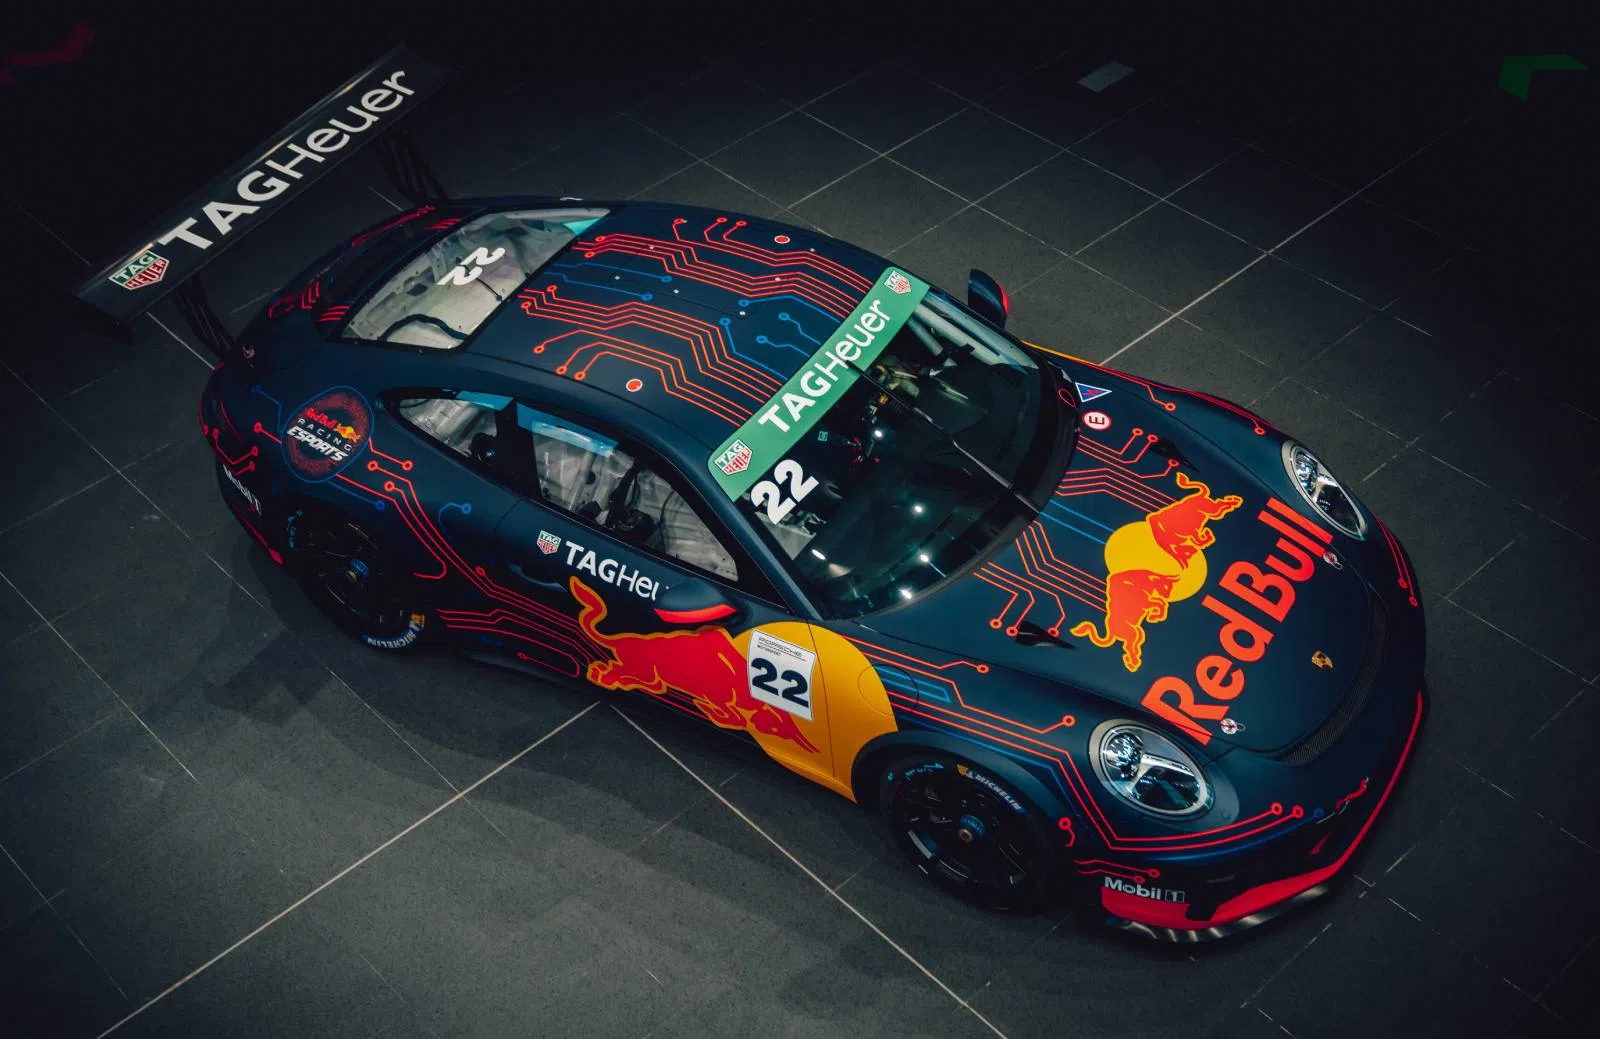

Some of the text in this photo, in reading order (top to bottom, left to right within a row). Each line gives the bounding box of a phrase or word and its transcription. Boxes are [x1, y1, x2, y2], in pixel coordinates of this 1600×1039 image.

[113, 253, 157, 280] TAG
[125, 258, 166, 288] HEUER
[436, 246, 505, 285] 22
[1088, 415, 1105, 425] E
[286, 425, 349, 462] ESPORTS
[297, 418, 353, 452] RACING
[717, 442, 745, 466] TAG
[750, 459, 819, 525] 22
[541, 532, 559, 545] TAG
[367, 629, 417, 649] MICHELIN
[751, 657, 809, 709] 22
[1103, 876, 1161, 900] Mobil
